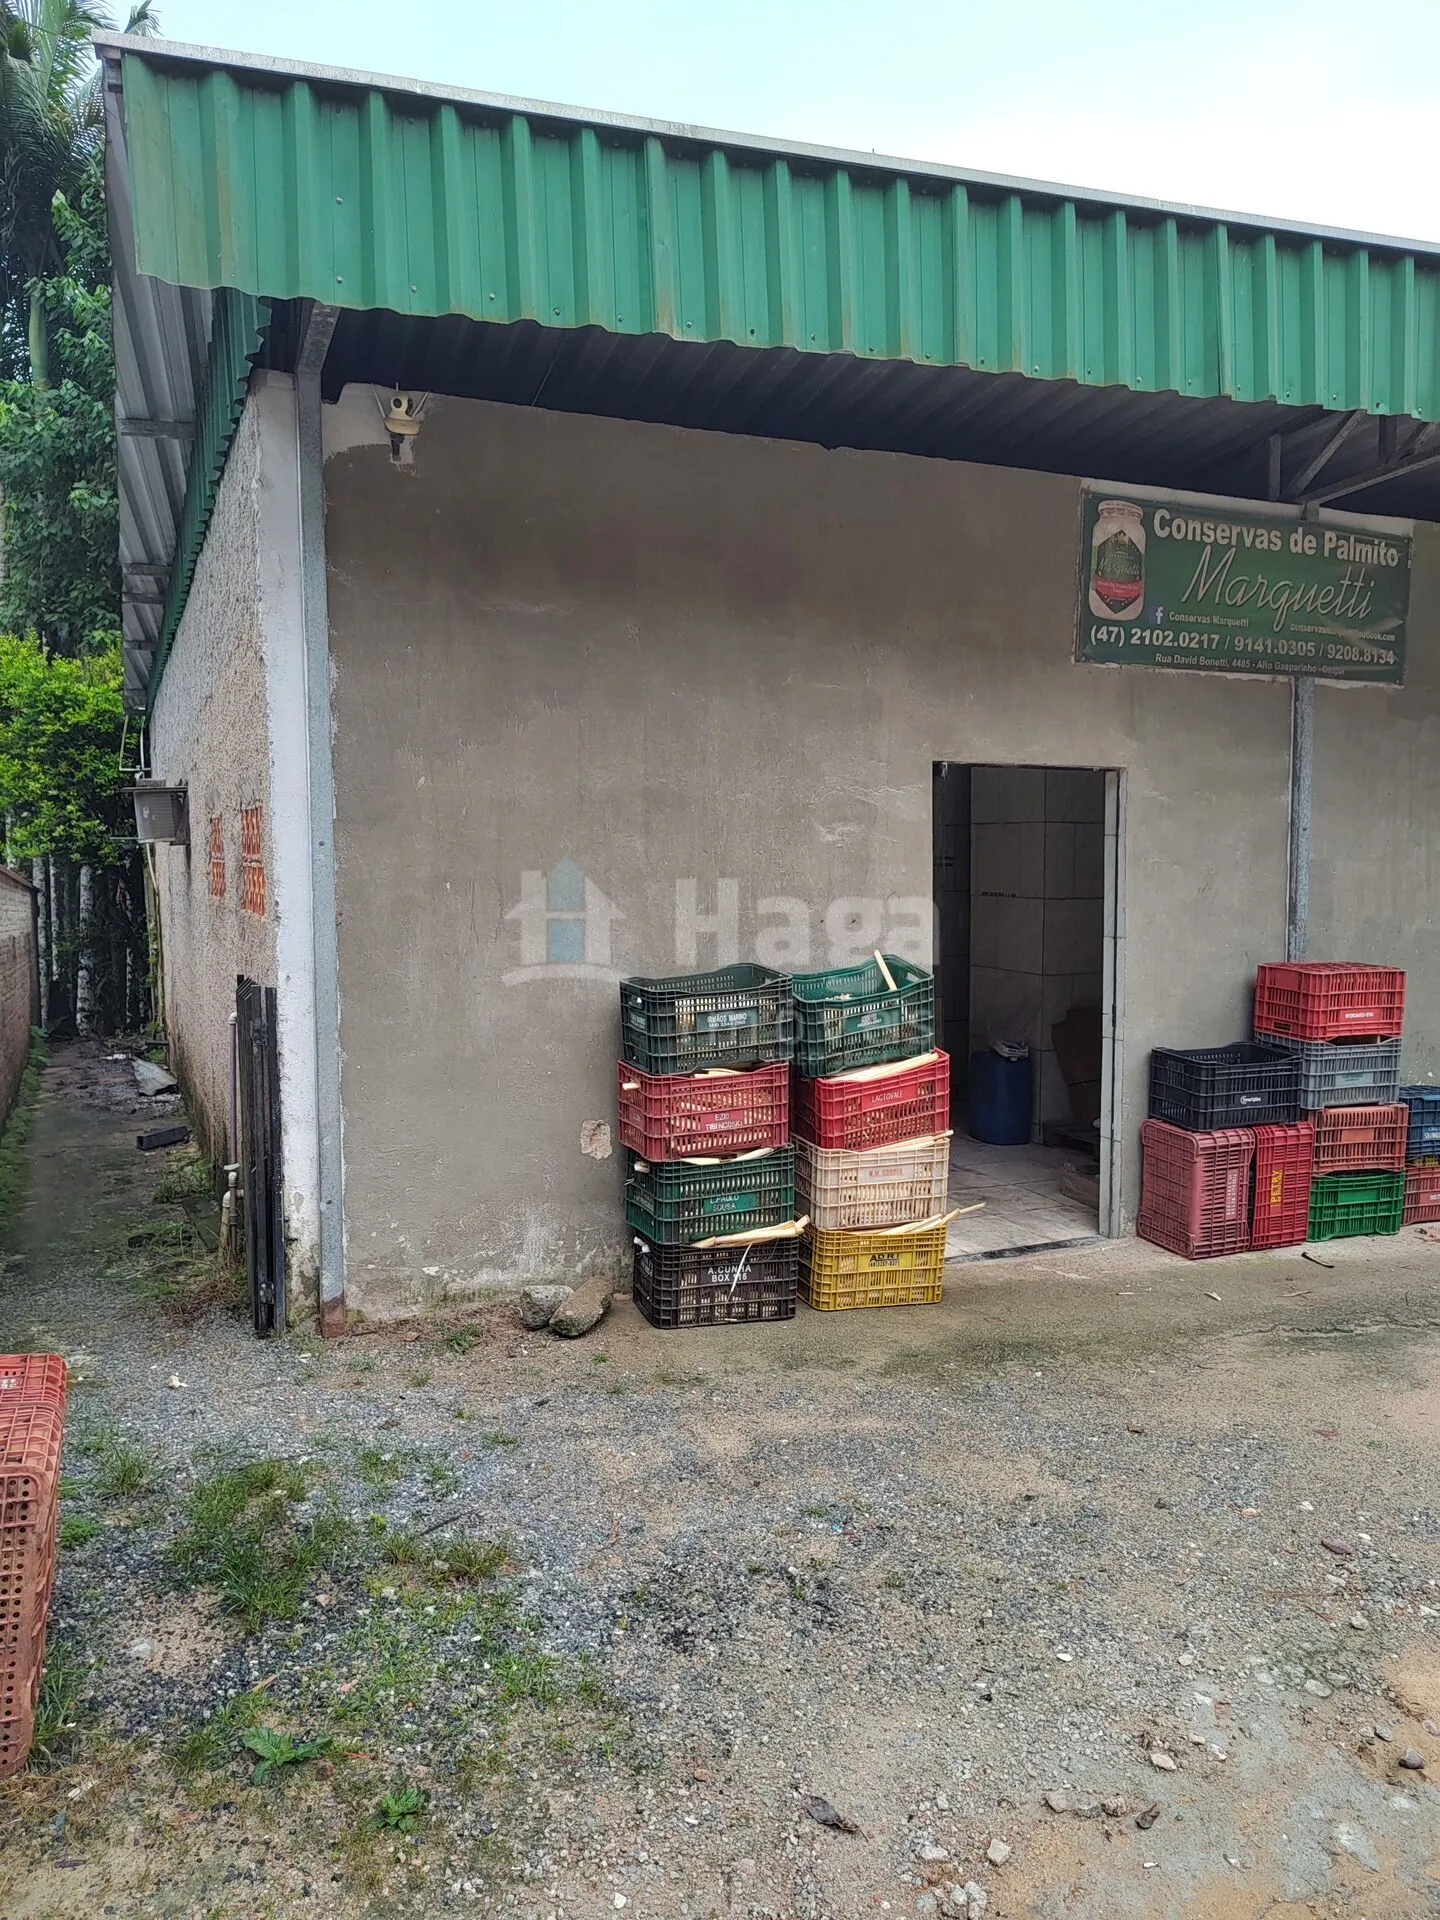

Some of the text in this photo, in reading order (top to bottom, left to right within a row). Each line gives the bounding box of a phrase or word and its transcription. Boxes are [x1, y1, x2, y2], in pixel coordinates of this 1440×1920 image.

[1153, 508, 1399, 568] Conservas de Palmito
[1181, 544, 1375, 633] Marquetti
[1169, 611, 1249, 628] Conservas Marquetti
[1090, 625, 1125, 647] (47)
[1130, 628, 1221, 650] 2102.0217
[1234, 636, 1316, 657] 9141.0305
[1327, 644, 1395, 665] 9208.8134
[1155, 653, 1172, 663] Rua
[1174, 654, 1197, 665] David
[1256, 660, 1272, 670] Alto
[1274, 662, 1317, 673] Gasparinho
[711, 1274, 730, 1282] BOX
